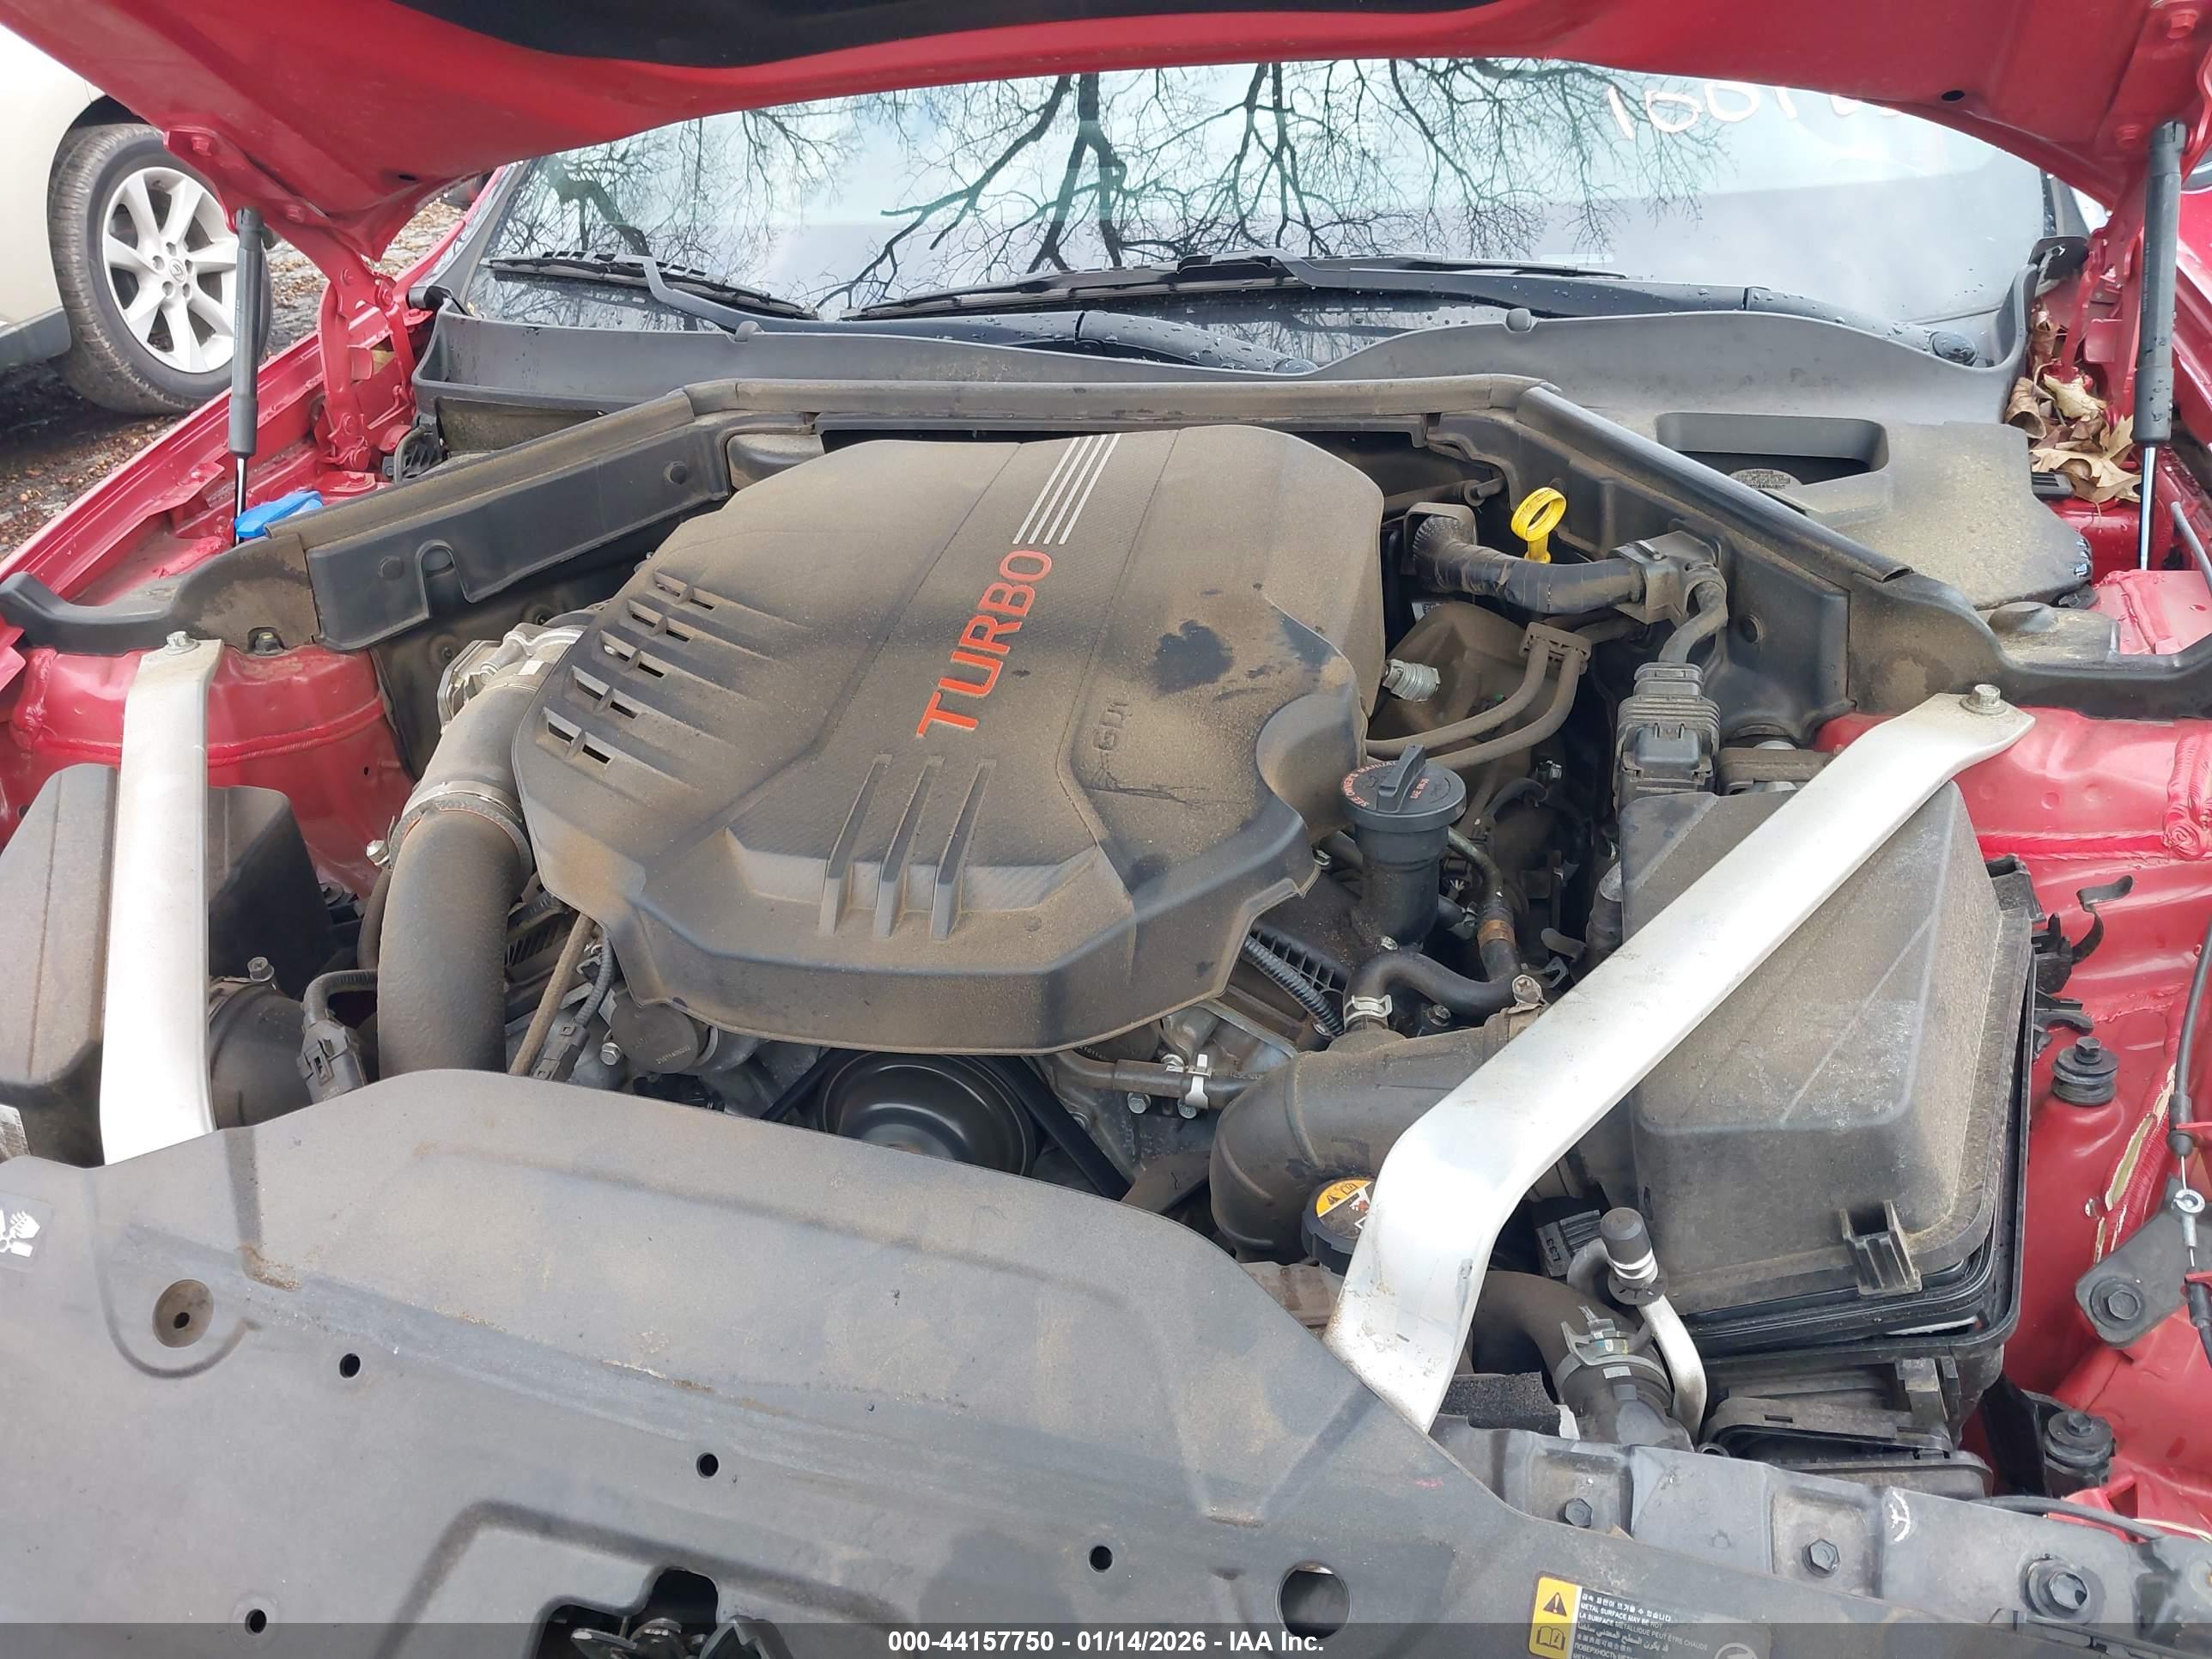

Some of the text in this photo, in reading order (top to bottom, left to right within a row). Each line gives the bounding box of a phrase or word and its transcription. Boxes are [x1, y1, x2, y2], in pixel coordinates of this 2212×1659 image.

[916, 550, 1053, 738] TURBO
[1580, 1602, 1662, 1630] METAL SURFACE MAY BE HOT
[1587, 1614, 1614, 1627] SURFACE
[1650, 1630, 1667, 1641] PEUT
[1683, 1638, 1709, 1651] CHAUDE
